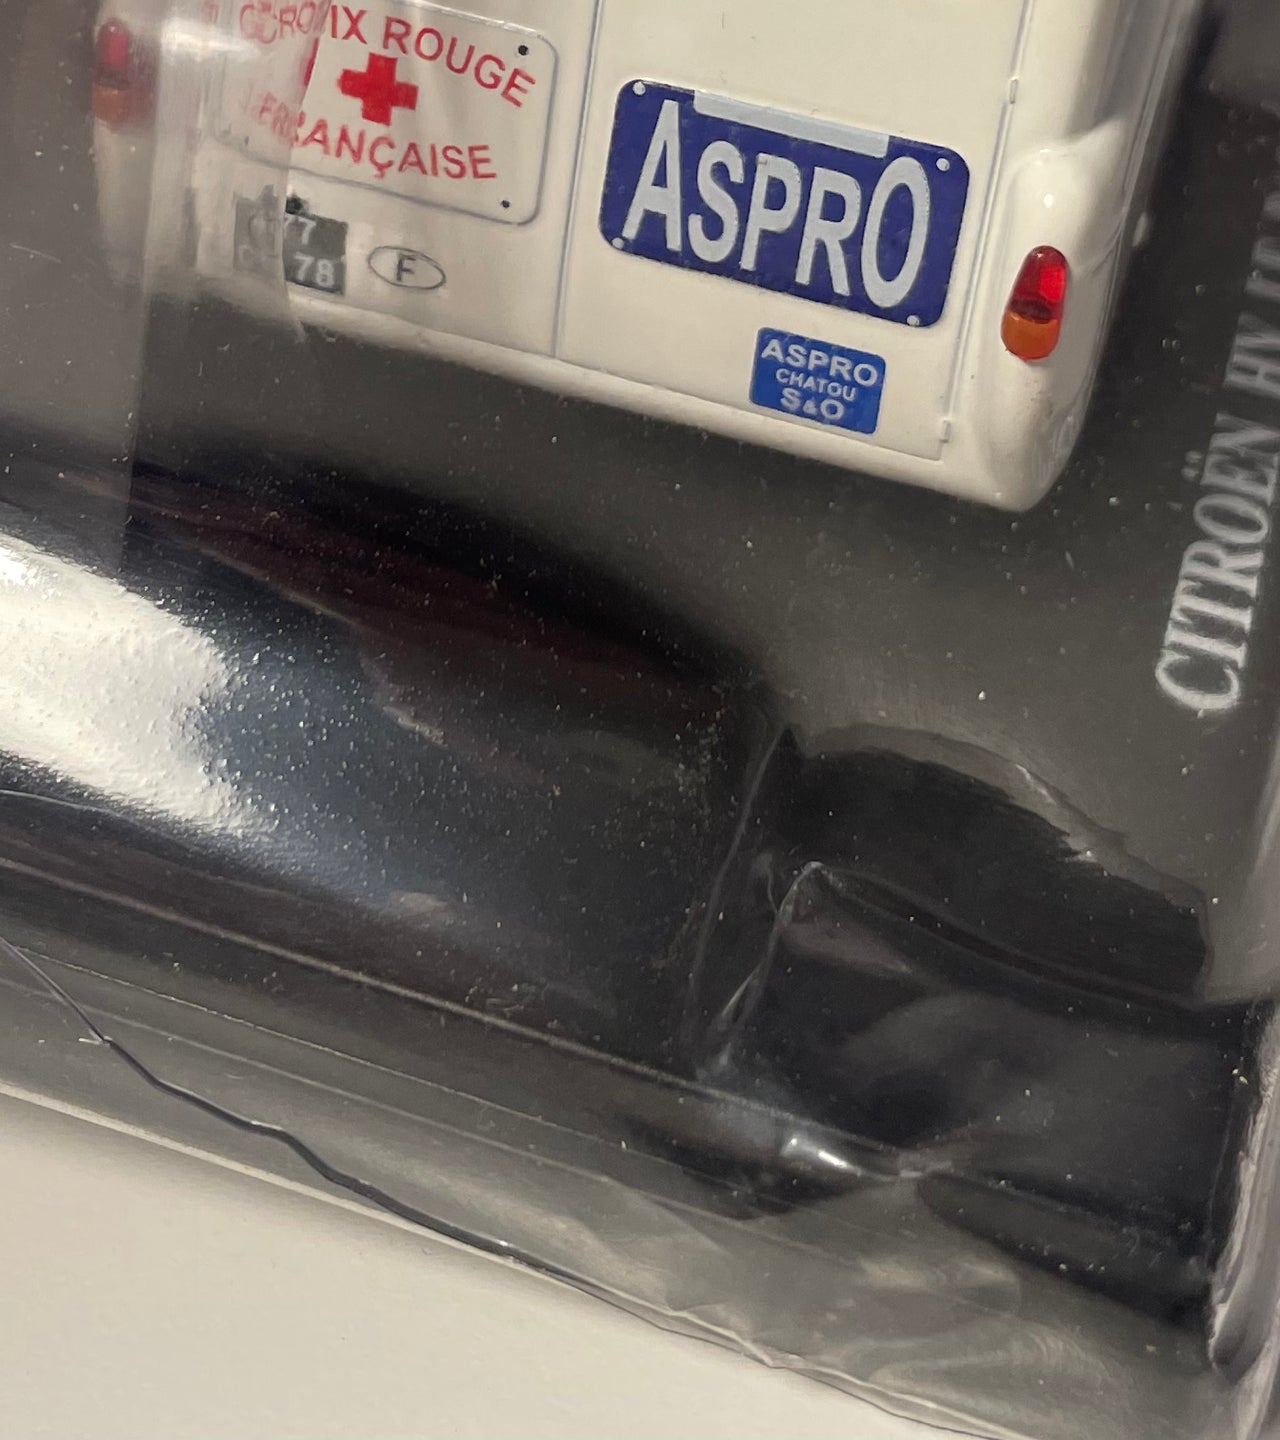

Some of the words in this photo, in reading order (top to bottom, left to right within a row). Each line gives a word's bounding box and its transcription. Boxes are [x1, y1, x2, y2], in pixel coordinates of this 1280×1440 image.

[383, 16, 536, 107] ROUGE
[622, 99, 931, 309] ASPRO
[395, 255, 417, 282] F
[761, 338, 878, 387] ASPRO
[775, 368, 857, 402] CHATOU
